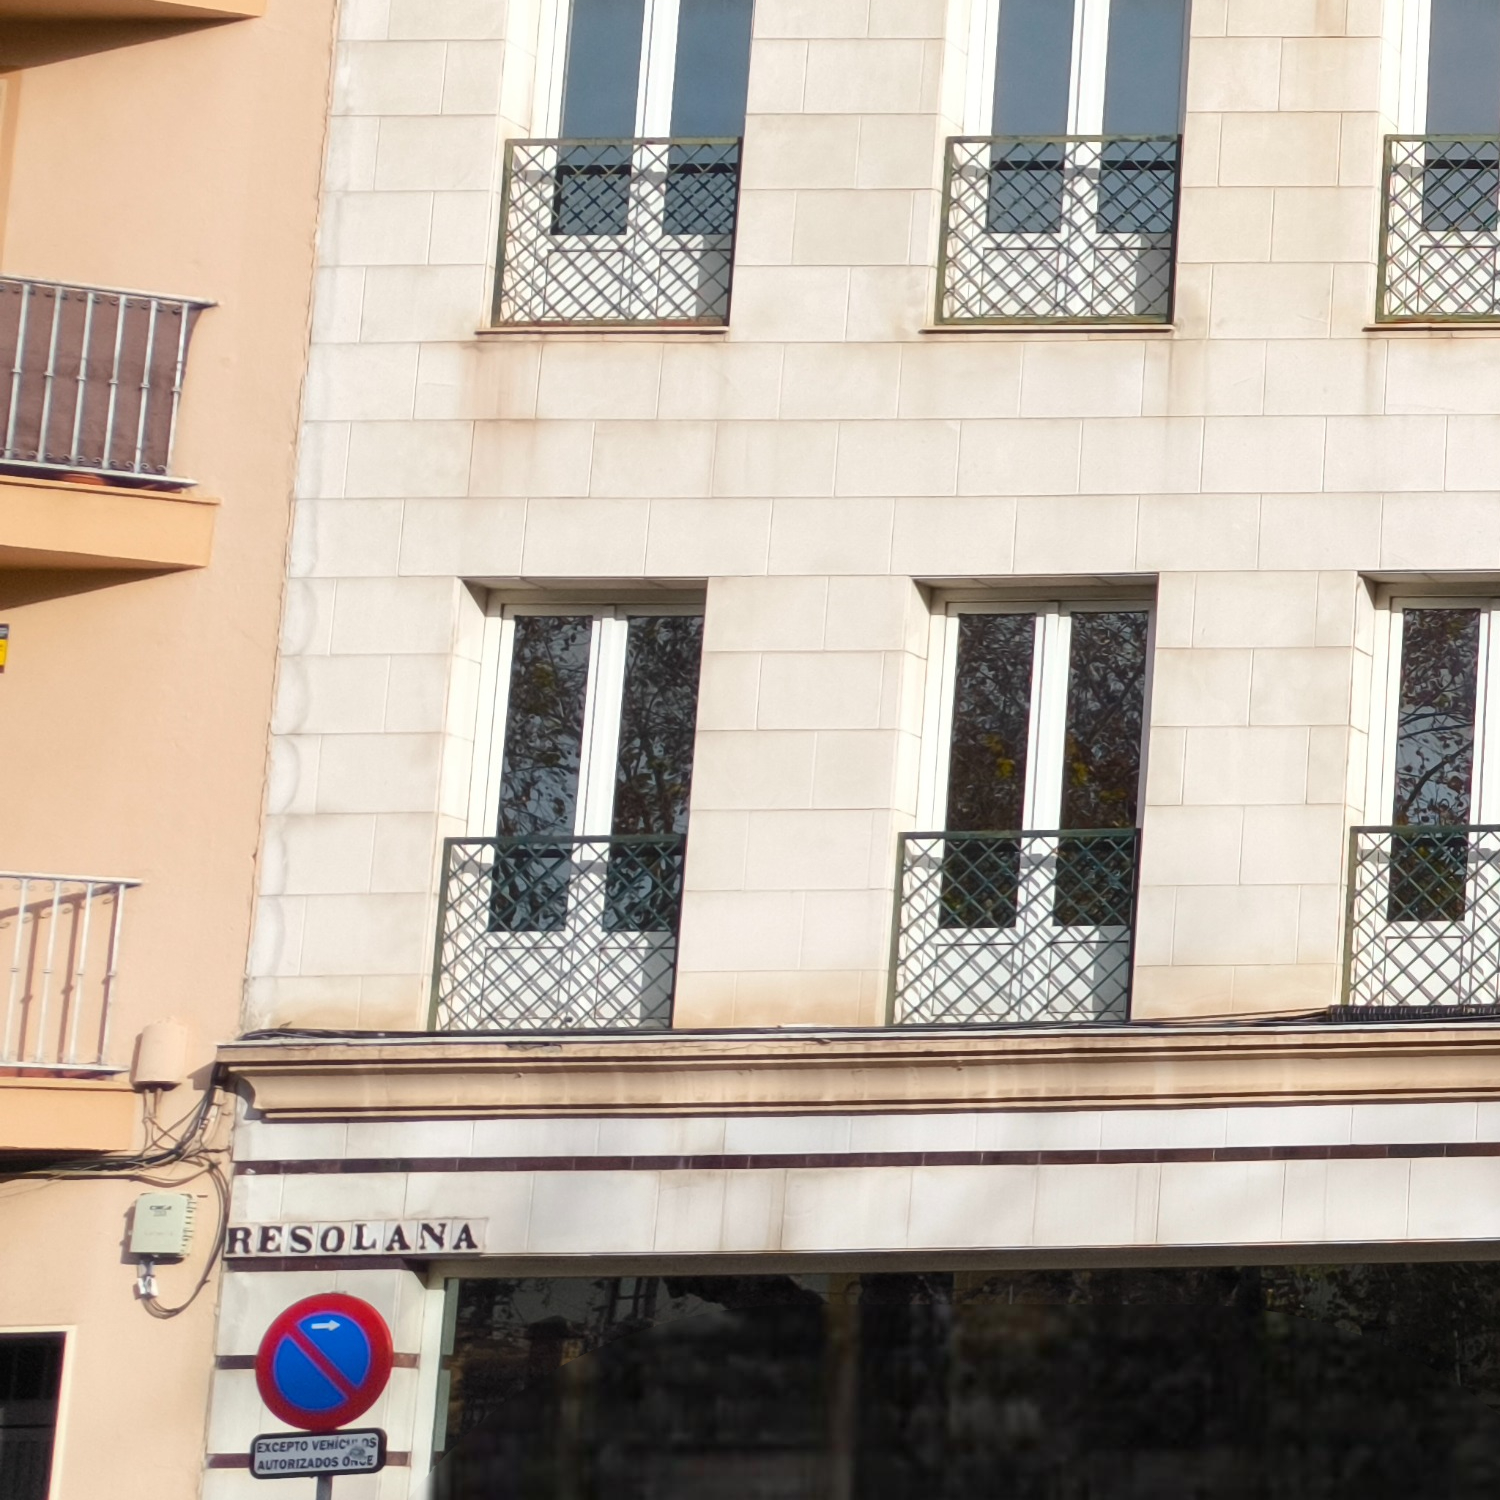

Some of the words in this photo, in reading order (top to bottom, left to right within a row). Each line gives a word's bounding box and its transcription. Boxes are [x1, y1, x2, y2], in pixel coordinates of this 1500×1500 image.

[228, 1223, 478, 1254] RESOLANA
[256, 1441, 309, 1453] EXCEPTO
[257, 1457, 339, 1470] AUTORIZADOS
